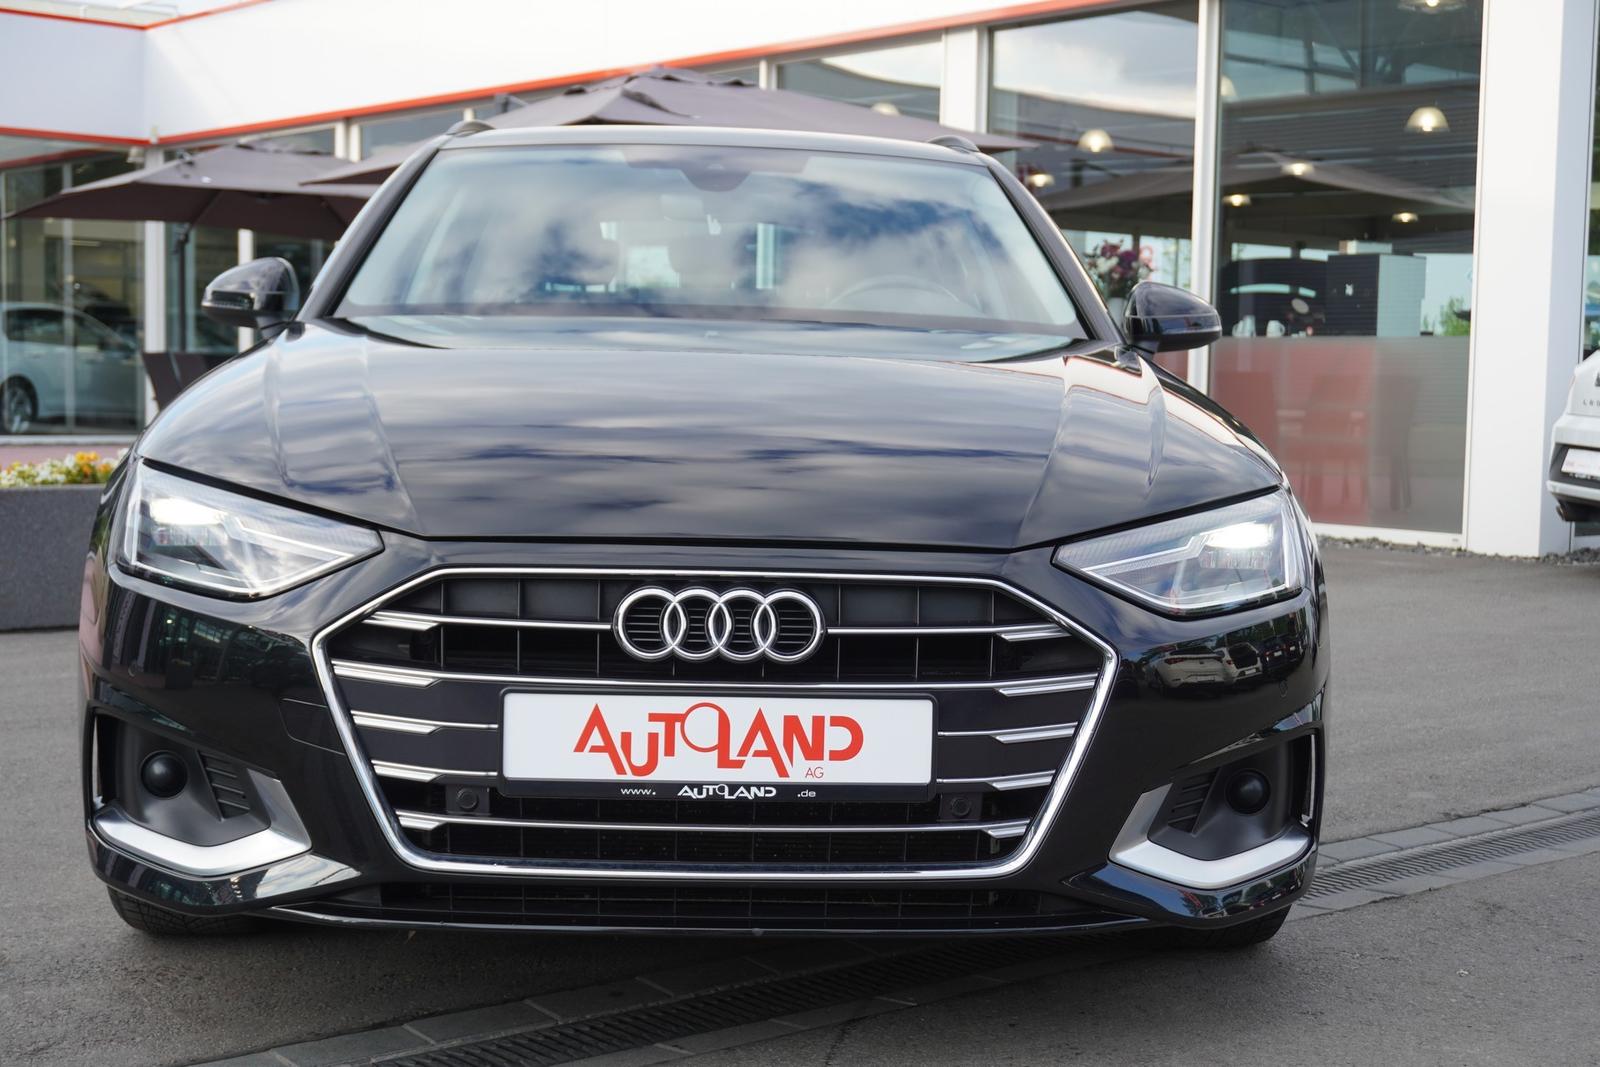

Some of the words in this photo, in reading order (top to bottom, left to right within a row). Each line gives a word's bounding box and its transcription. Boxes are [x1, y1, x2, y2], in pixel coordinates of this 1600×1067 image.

[573, 702, 864, 778] AUTOLAND
[805, 767, 824, 779] AG
[677, 784, 777, 799] AUTOLAND
